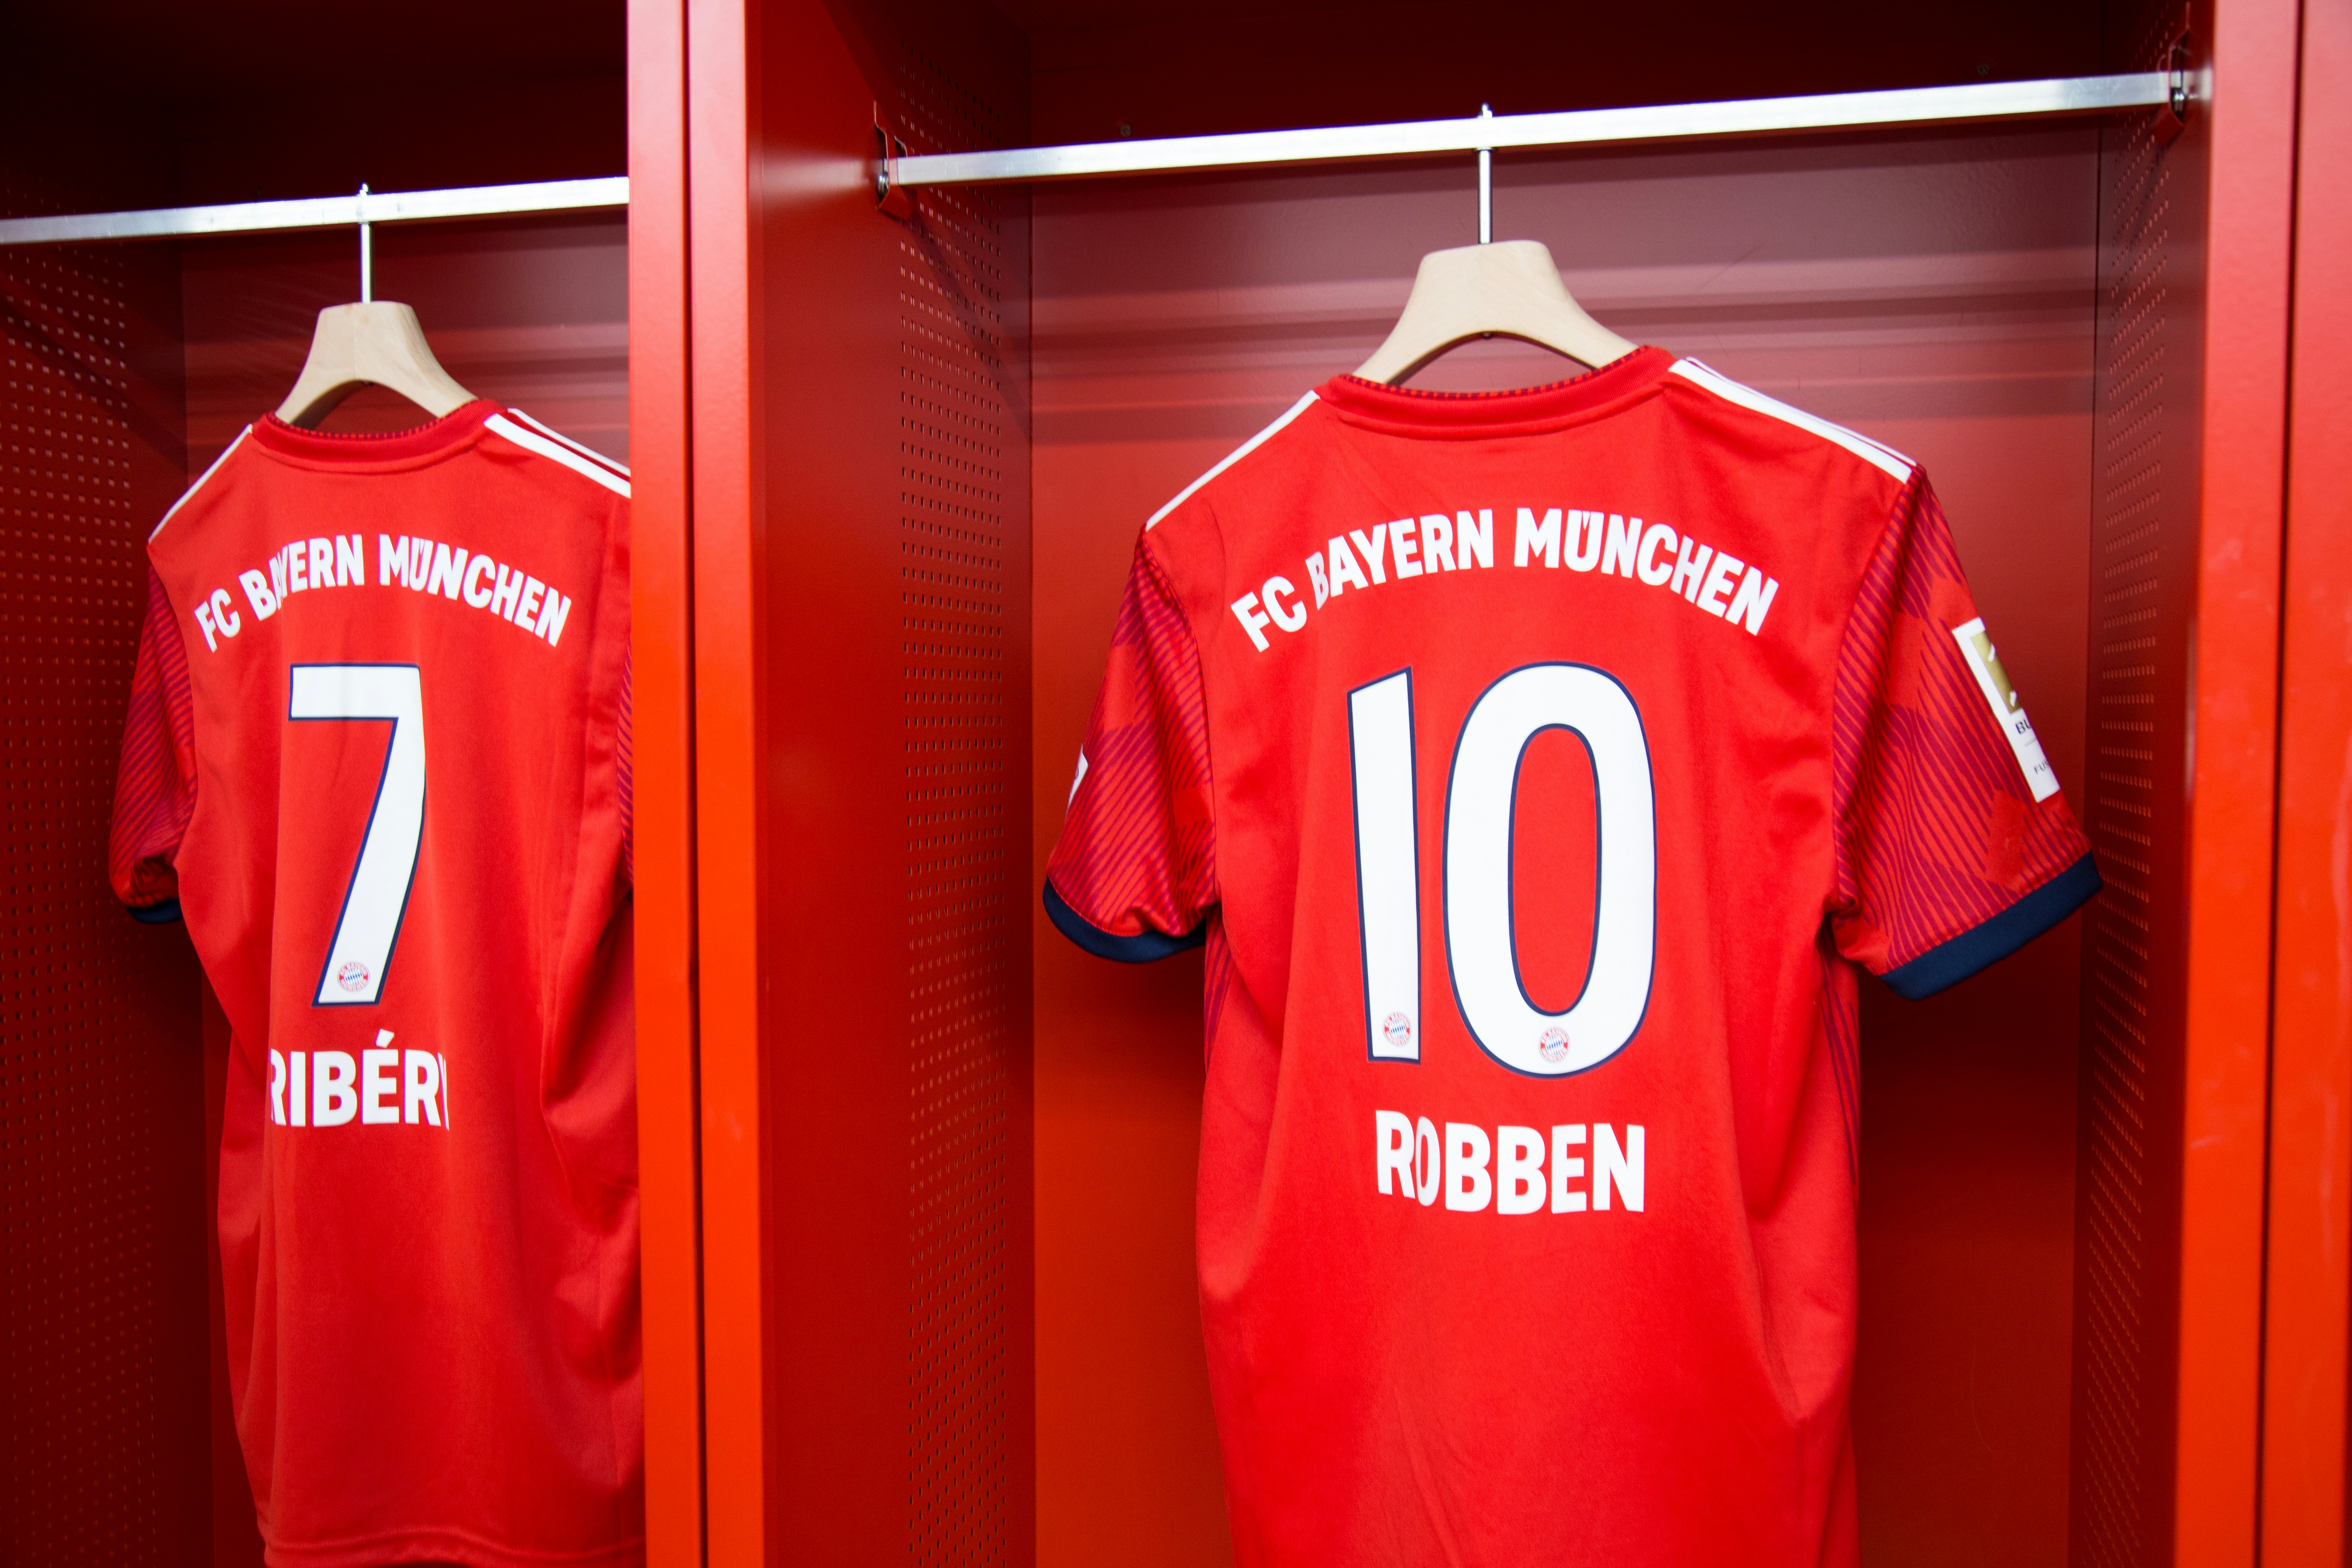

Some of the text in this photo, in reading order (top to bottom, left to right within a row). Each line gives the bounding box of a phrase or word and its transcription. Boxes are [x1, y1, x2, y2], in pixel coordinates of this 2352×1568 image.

[194, 534, 572, 653] FC BAYERN MÜNCHEN
[1230, 507, 1779, 652] FC BAYERN MÜNCHEN
[288, 662, 426, 1007] 7
[1347, 660, 1657, 1079] 10
[1375, 1110, 1645, 1215] ROBBEN
